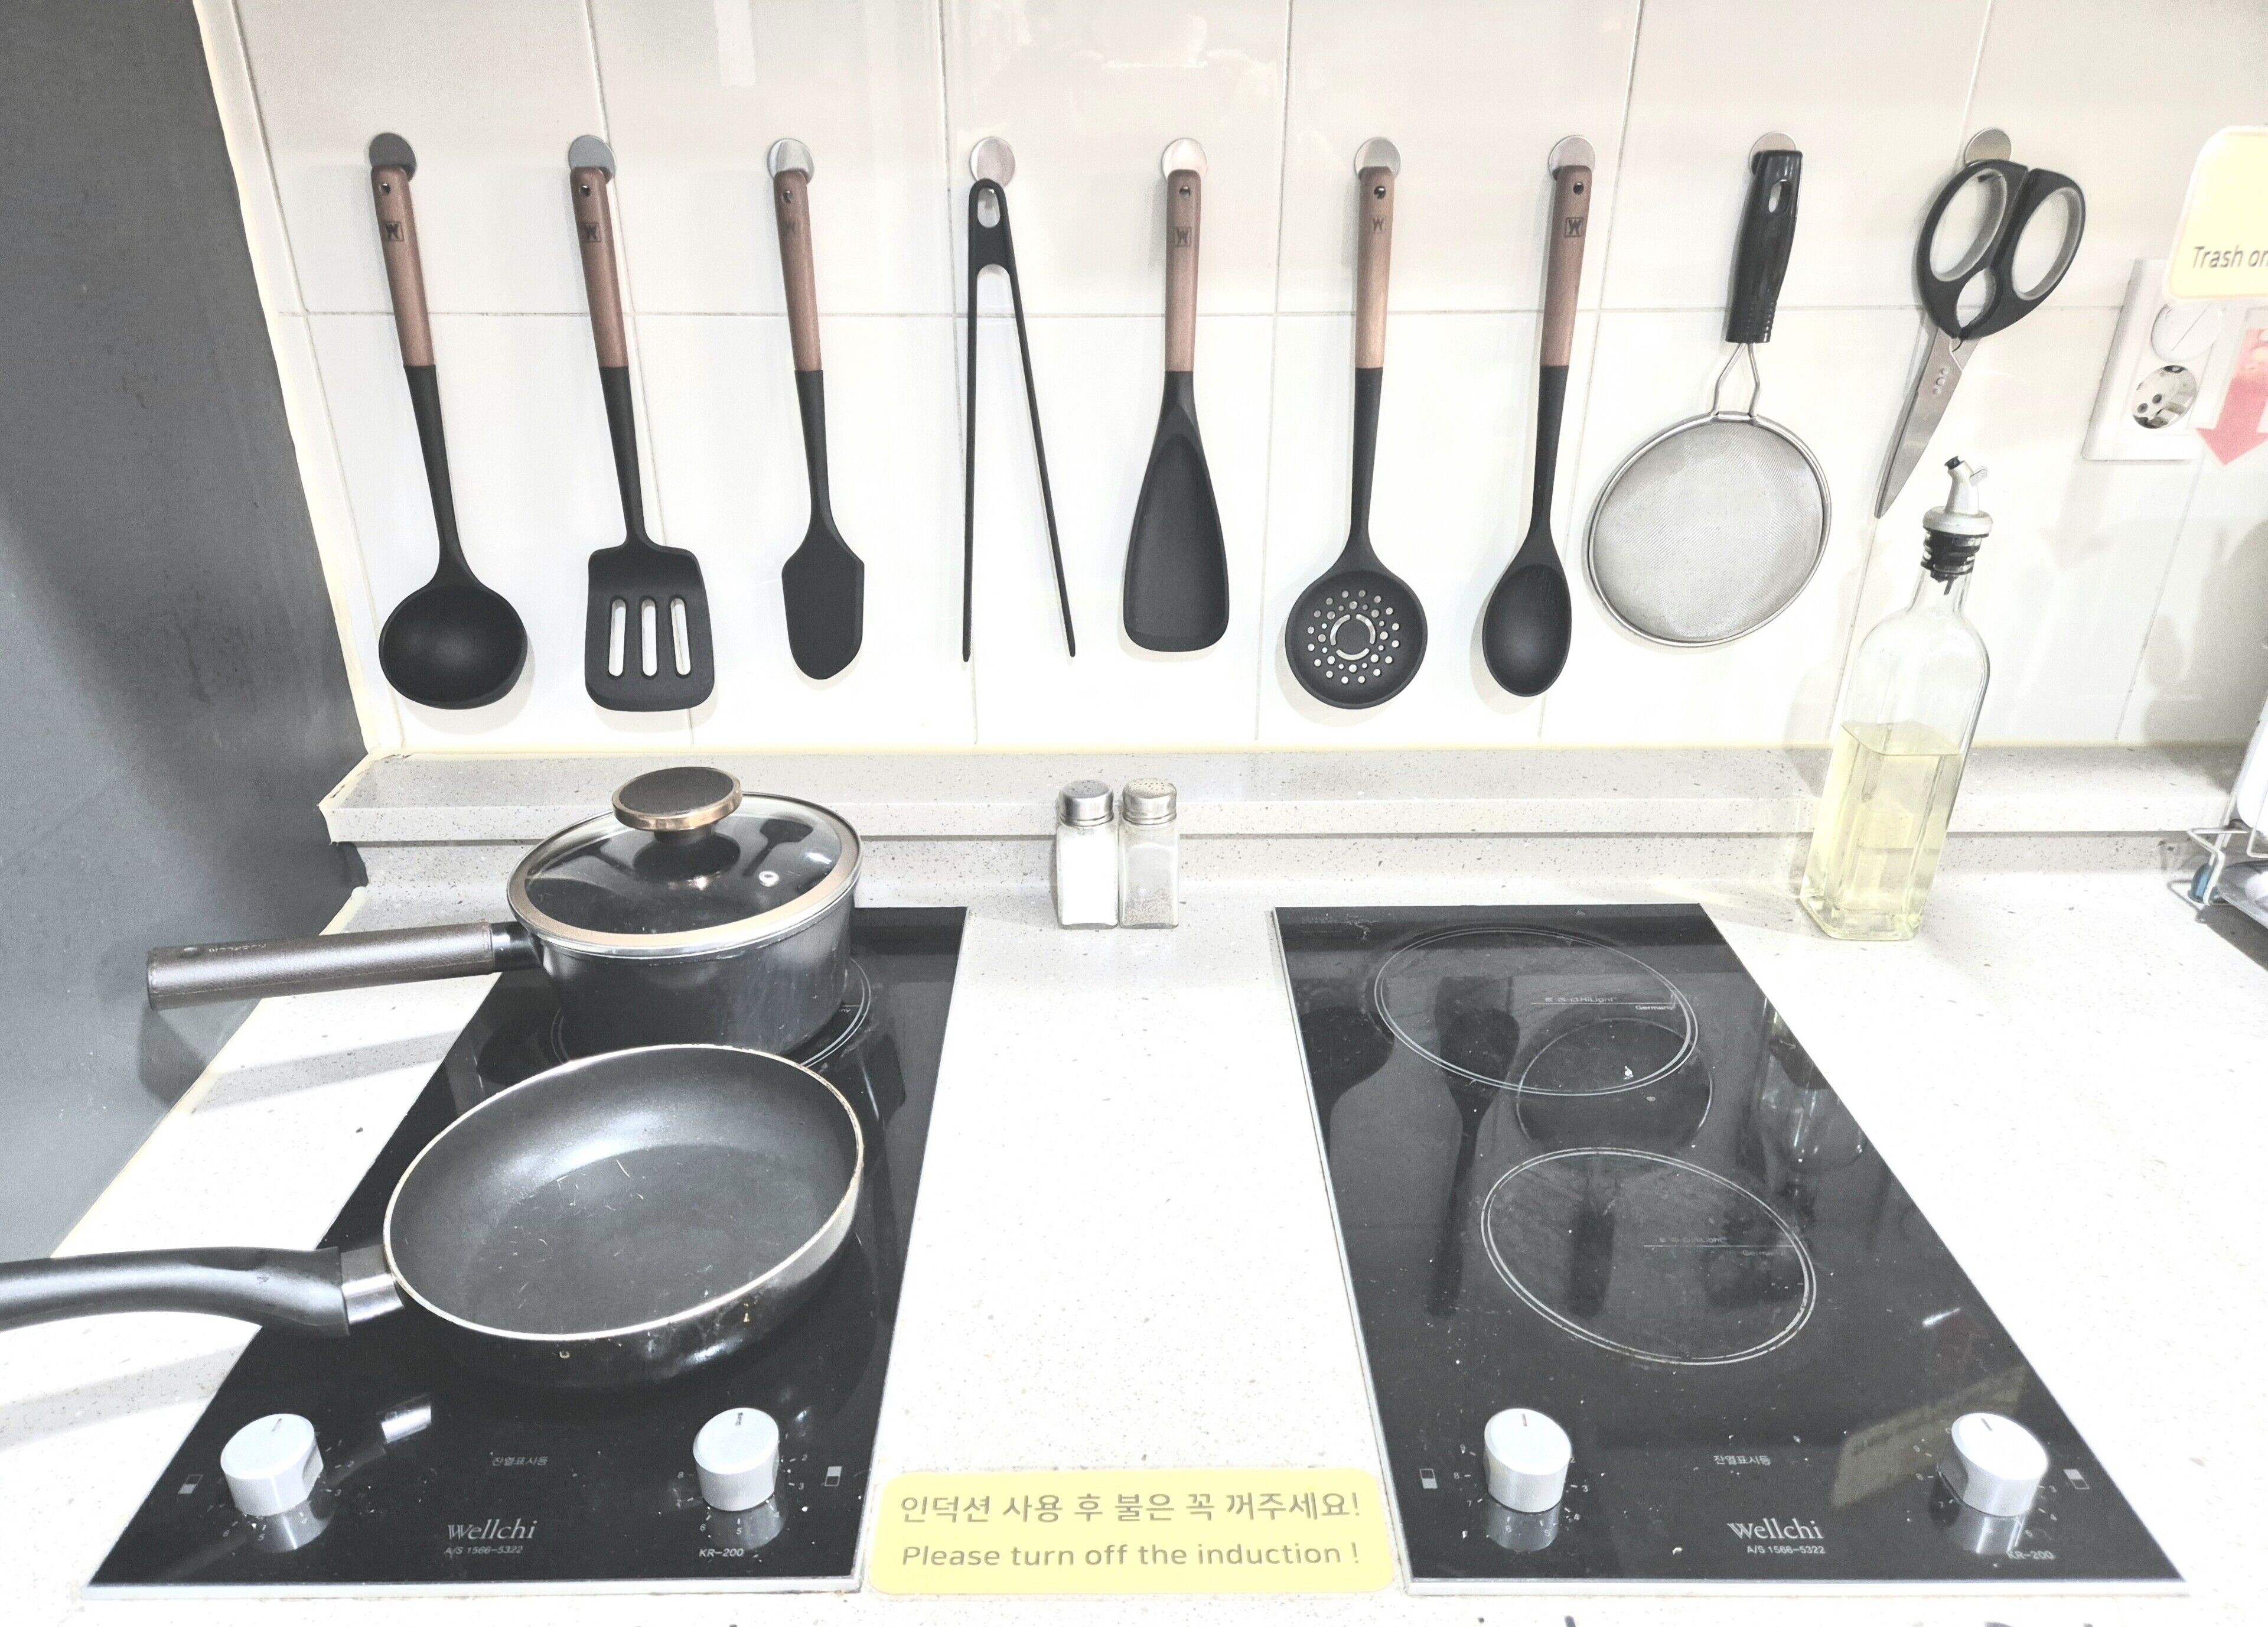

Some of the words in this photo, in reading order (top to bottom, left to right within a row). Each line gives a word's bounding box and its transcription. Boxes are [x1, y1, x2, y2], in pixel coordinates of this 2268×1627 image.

[2192, 245, 2244, 269] Trash
[901, 1495, 990, 1523] 인덕션
[1002, 1494, 1063, 1523] 사용
[1074, 1493, 1103, 1522] 후
[1114, 1493, 1175, 1522] 불은
[1185, 1493, 1215, 1521] 꼭
[1226, 1492, 1360, 1520] 꺼주세요!
[447, 1518, 537, 1539] Wellchi
[1726, 1517, 1824, 1539] Wellchi
[444, 1545, 463, 1555] A/S
[467, 1545, 524, 1554] 1566-5322
[699, 1548, 744, 1557] KR-200
[902, 1545, 1001, 1566] Please
[1011, 1547, 1074, 1566] turn
[1085, 1544, 1128, 1566] off
[1138, 1544, 1187, 1565] the
[1197, 1542, 1341, 1565] induction
[1351, 1541, 1360, 1564] !
[1746, 1545, 1765, 1554] A/S
[1768, 1545, 1826, 1554] 1566-5322
[2008, 1550, 2055, 1560] KR-200
